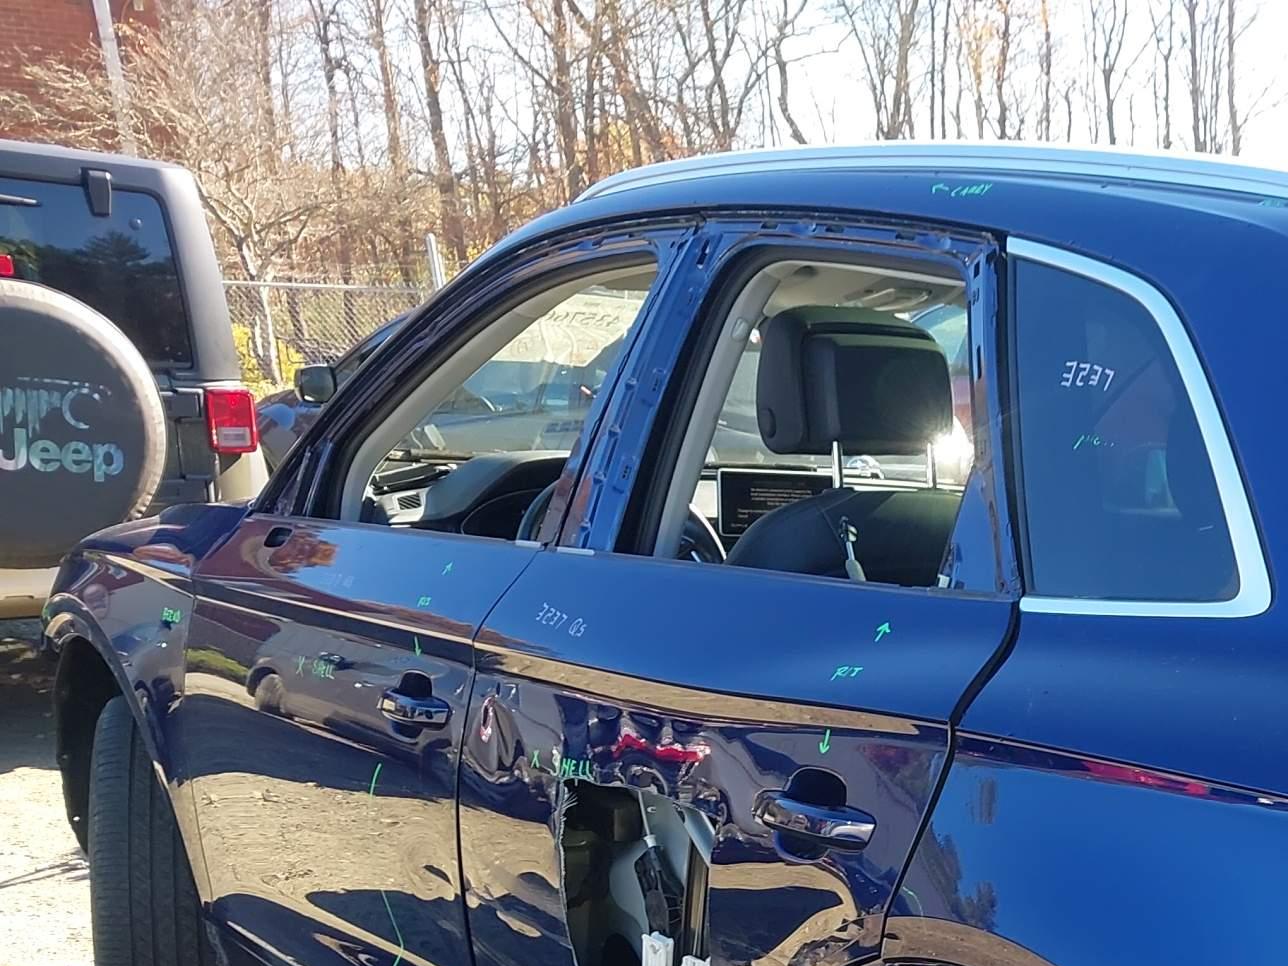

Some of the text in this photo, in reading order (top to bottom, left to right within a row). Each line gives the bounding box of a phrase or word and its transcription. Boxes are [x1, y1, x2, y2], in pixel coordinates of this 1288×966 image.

[1061, 361, 1115, 391] 3237
[0, 428, 124, 482] Jeep
[536, 602, 588, 637] 3237 Q5
